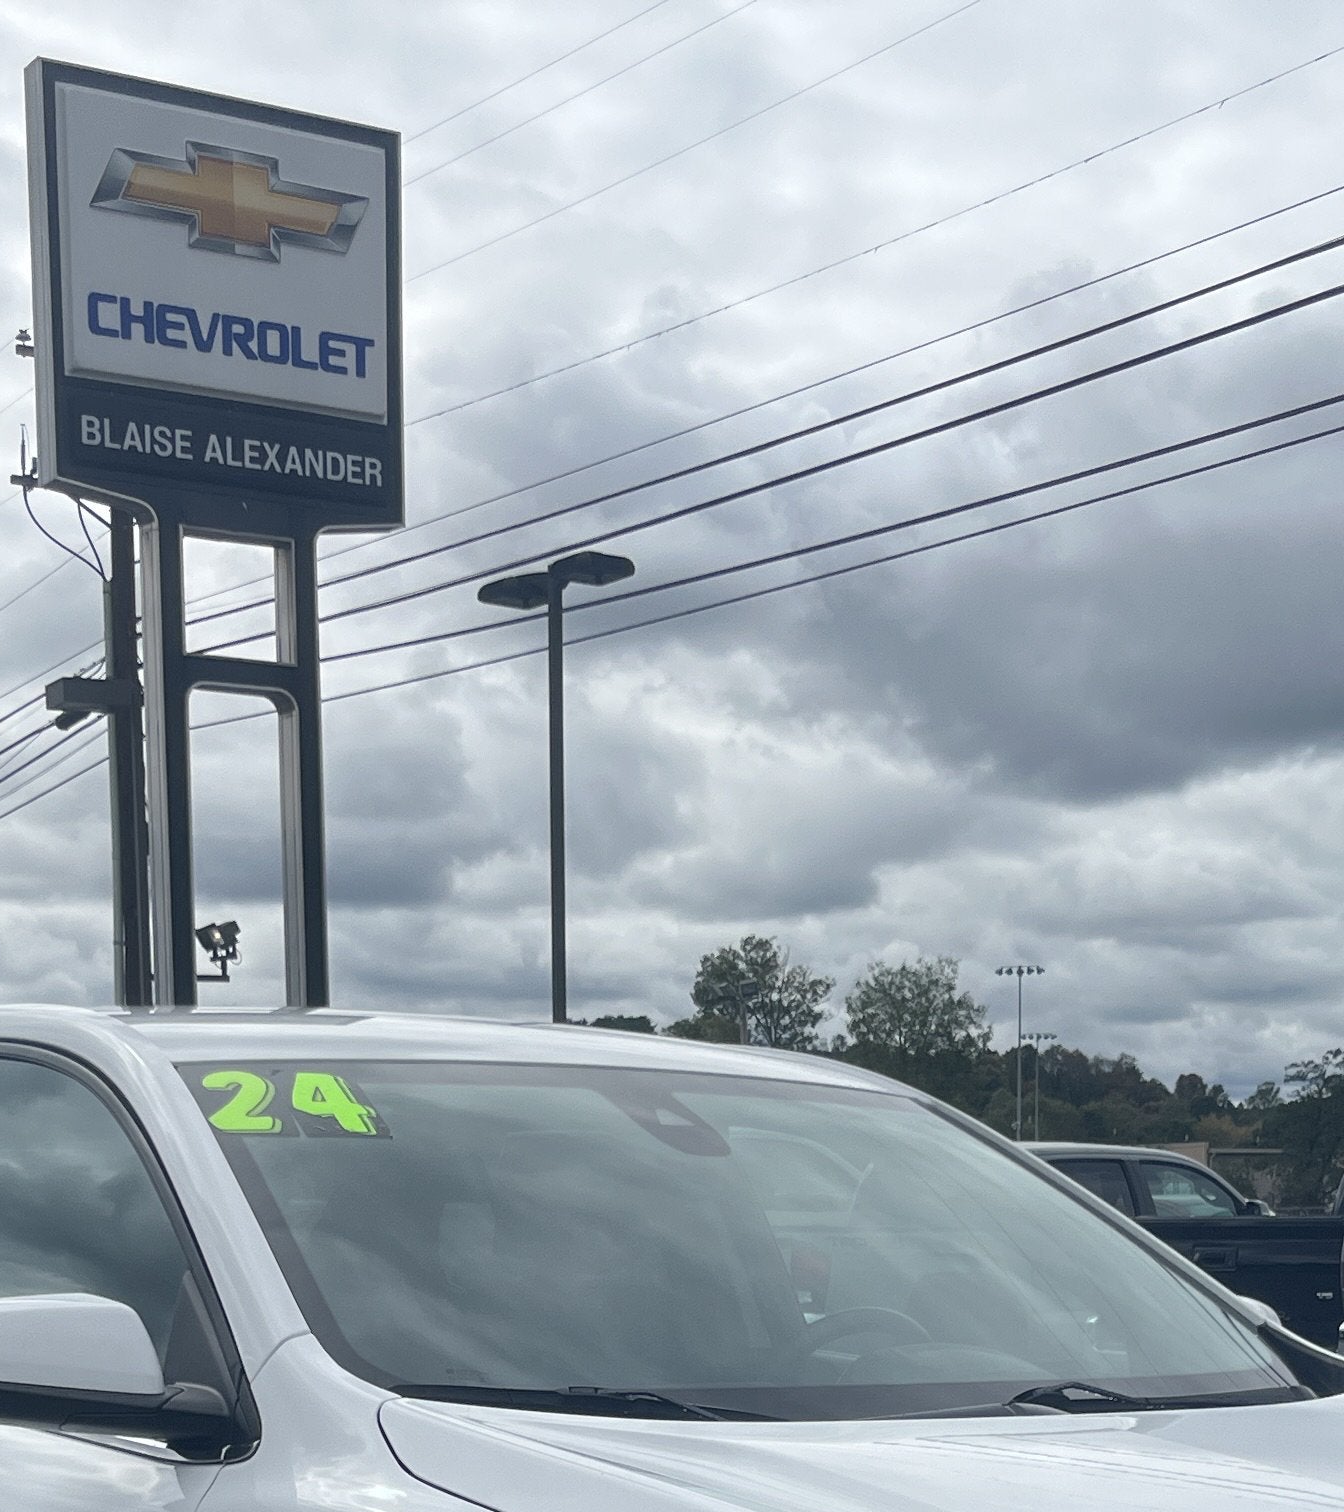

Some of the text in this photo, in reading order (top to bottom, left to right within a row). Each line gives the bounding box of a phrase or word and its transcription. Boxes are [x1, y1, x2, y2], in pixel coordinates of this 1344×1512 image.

[88, 292, 375, 379] CHEVROLET
[81, 414, 383, 487] BLAISE ALEXANDER
[202, 1070, 377, 1136] 24
